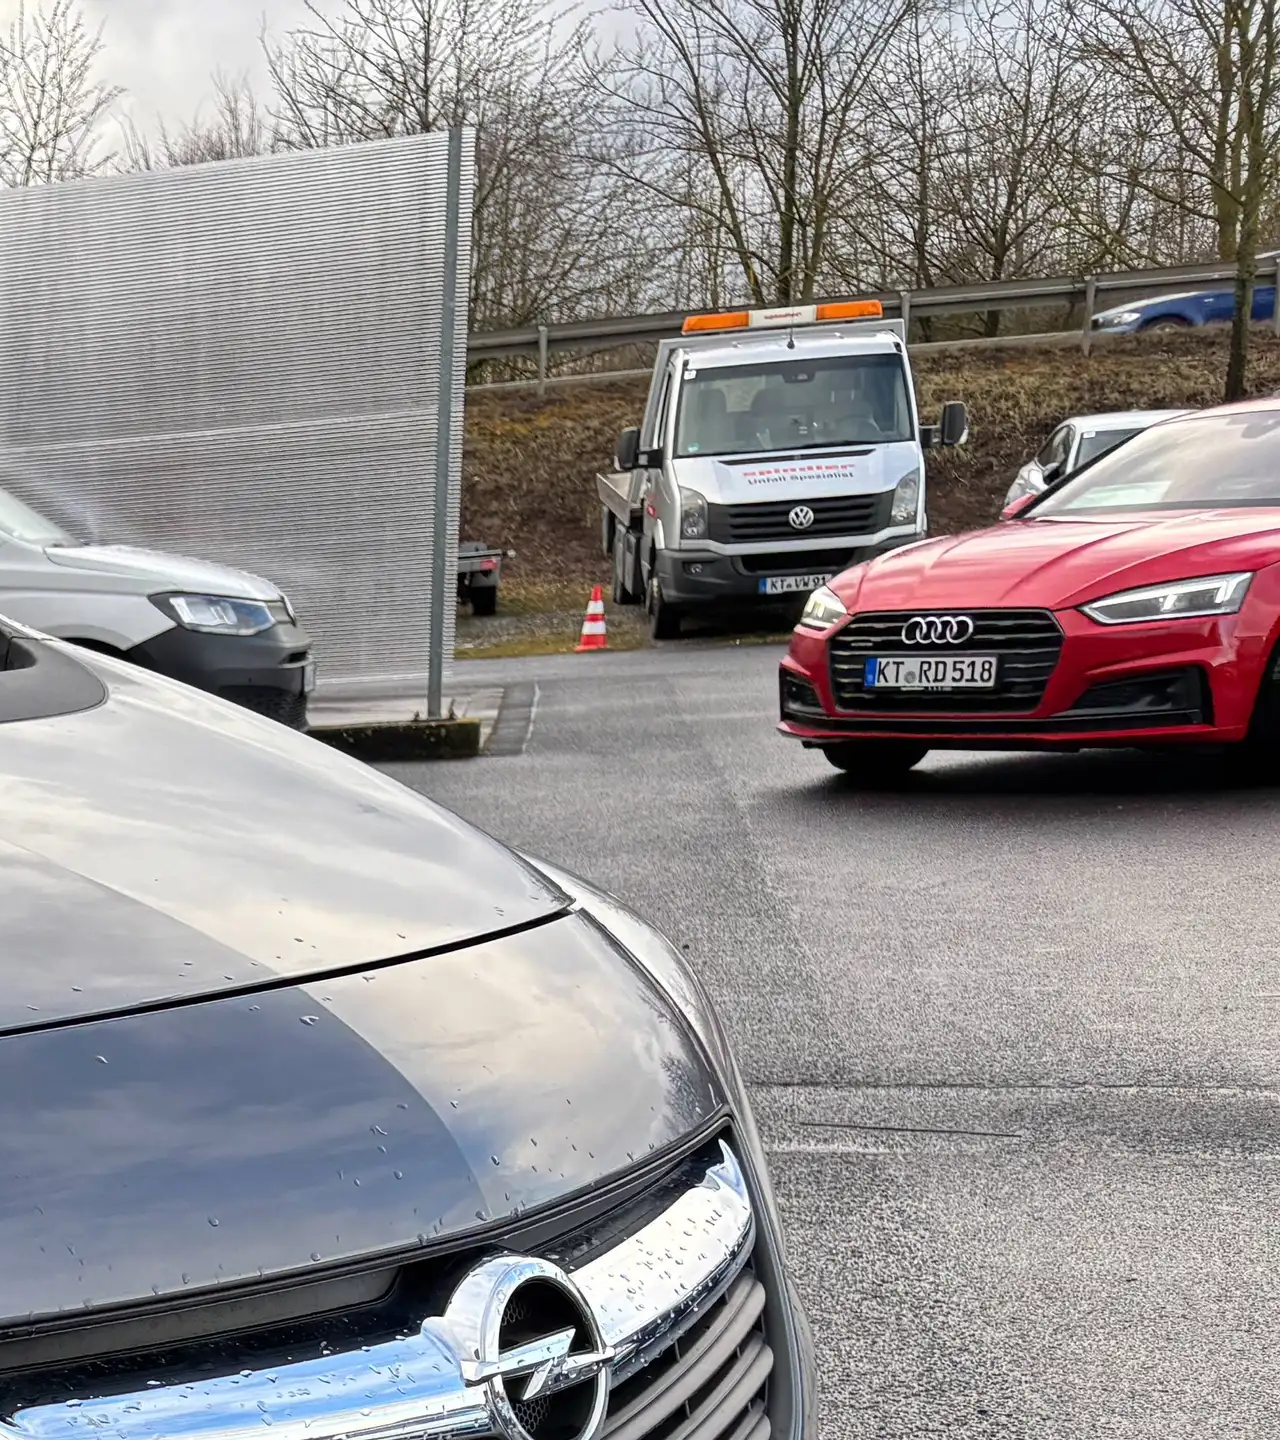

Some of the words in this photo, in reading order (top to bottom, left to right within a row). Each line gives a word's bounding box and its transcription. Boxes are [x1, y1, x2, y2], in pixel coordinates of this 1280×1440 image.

[877, 660, 905, 684] KT
[918, 660, 948, 683] RD
[951, 660, 993, 683] 518
